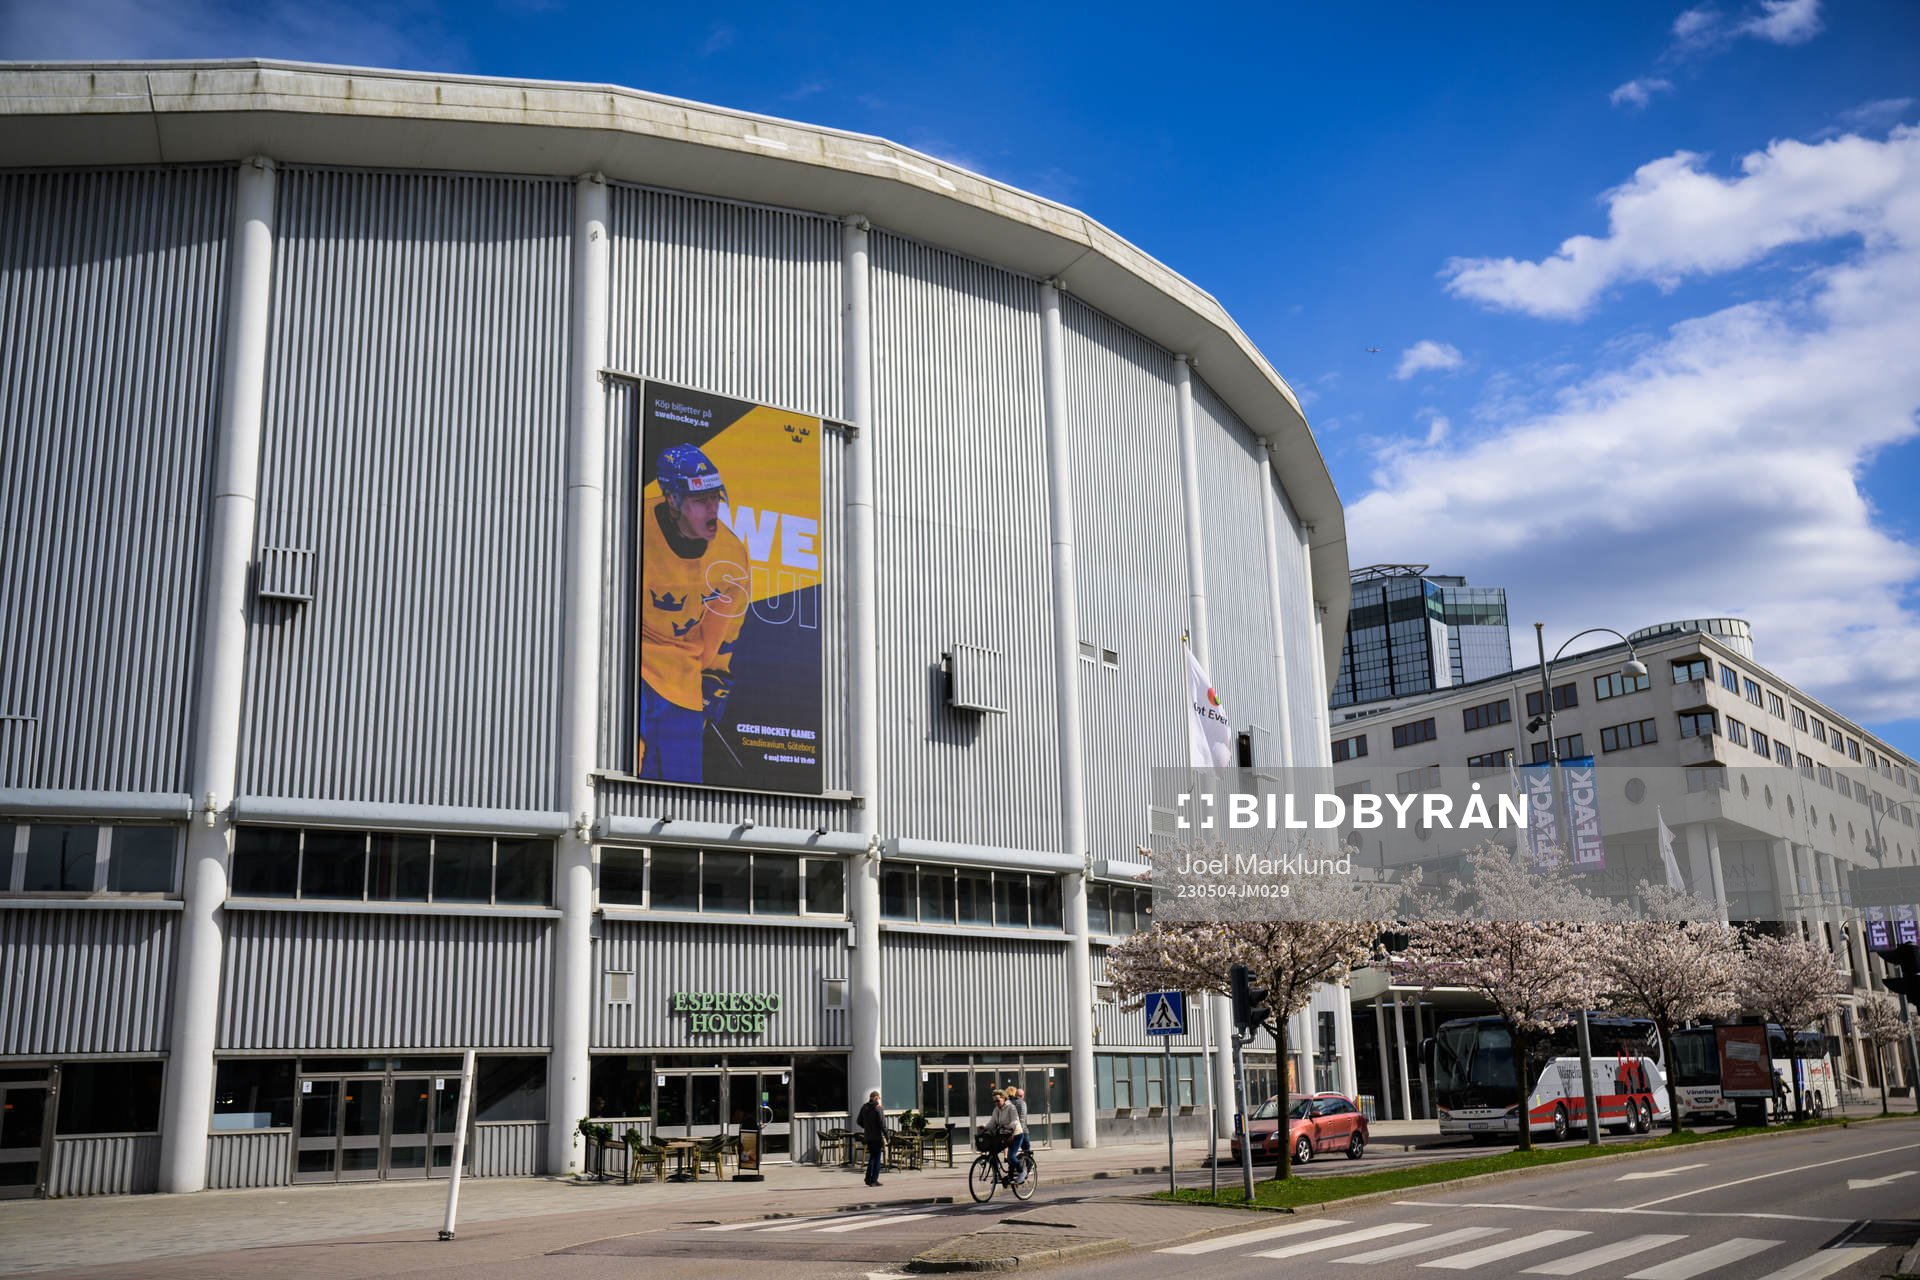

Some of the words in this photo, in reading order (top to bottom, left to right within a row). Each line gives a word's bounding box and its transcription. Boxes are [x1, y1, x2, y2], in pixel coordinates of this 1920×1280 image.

[655, 399, 670, 410] Köp
[671, 402, 701, 415] biljetter
[703, 409, 713, 418] på
[655, 411, 710, 427] swehockey.se
[718, 502, 818, 571] WE
[703, 560, 817, 629] SUI
[736, 723, 761, 734] CZECH
[761, 725, 790, 737] HOCKEY
[791, 728, 816, 739] GAMES
[742, 737, 787, 750] Scandinavium,
[787, 740, 816, 754] Göteborg
[763, 753, 768, 761] 4
[768, 754, 780, 763] maj
[780, 755, 794, 763] 2023
[673, 991, 783, 1013] ESPRESSO
[690, 1012, 768, 1033] HOUSE
